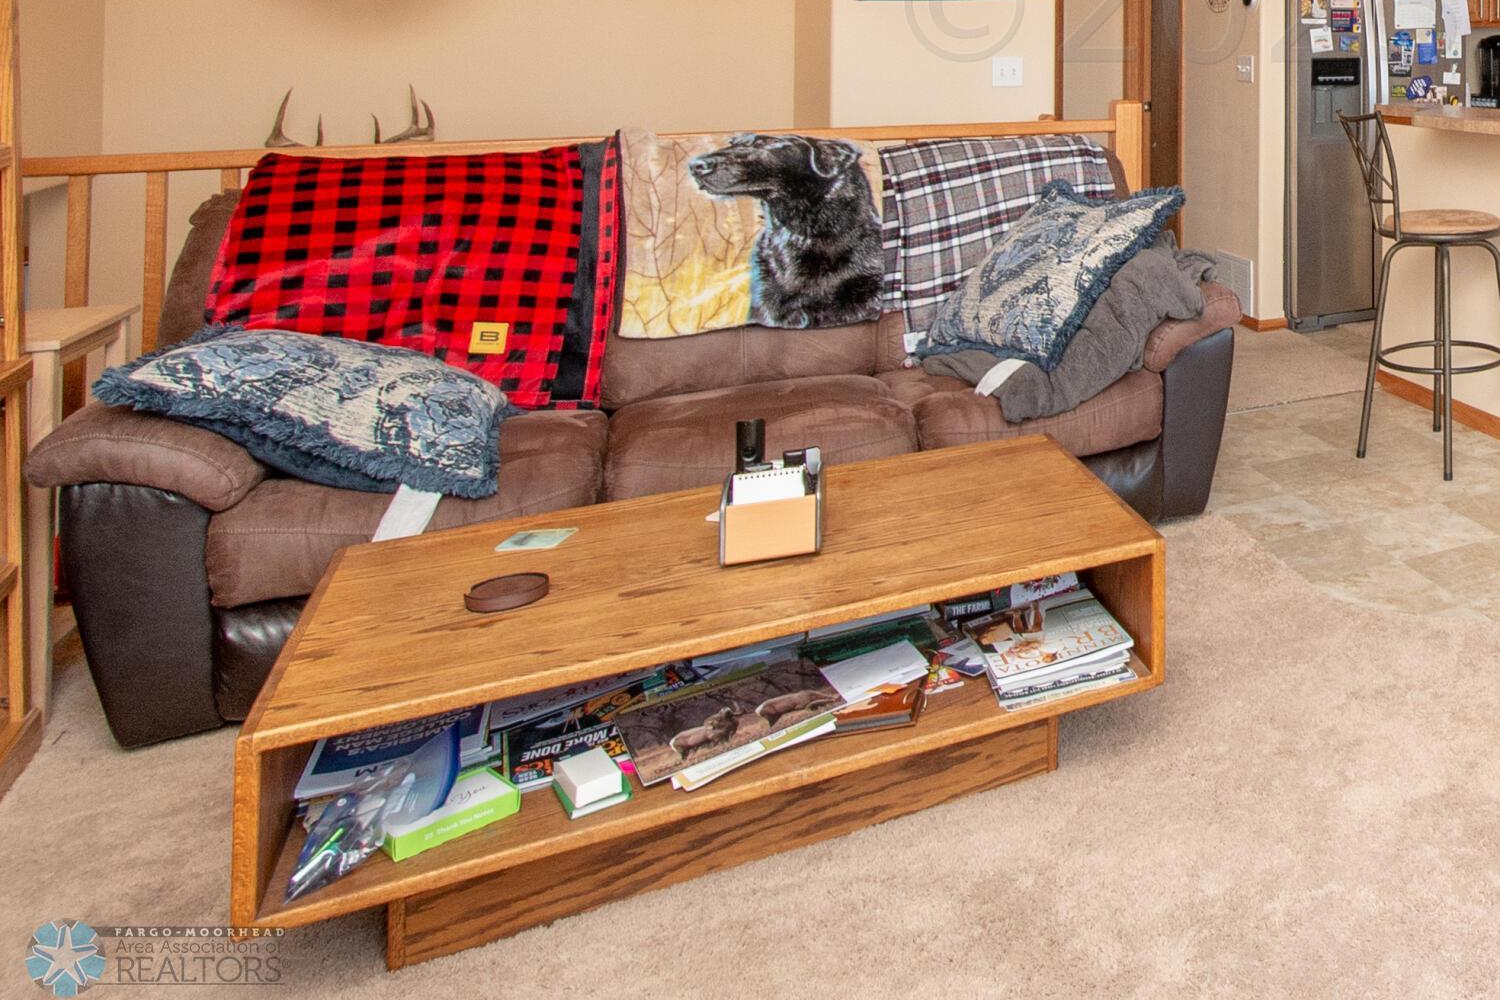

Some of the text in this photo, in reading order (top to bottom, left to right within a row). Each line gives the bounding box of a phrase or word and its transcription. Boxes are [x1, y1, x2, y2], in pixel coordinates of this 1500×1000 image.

[480, 331, 500, 341] B
[952, 604, 967, 616] THE
[521, 744, 562, 762] DONE
